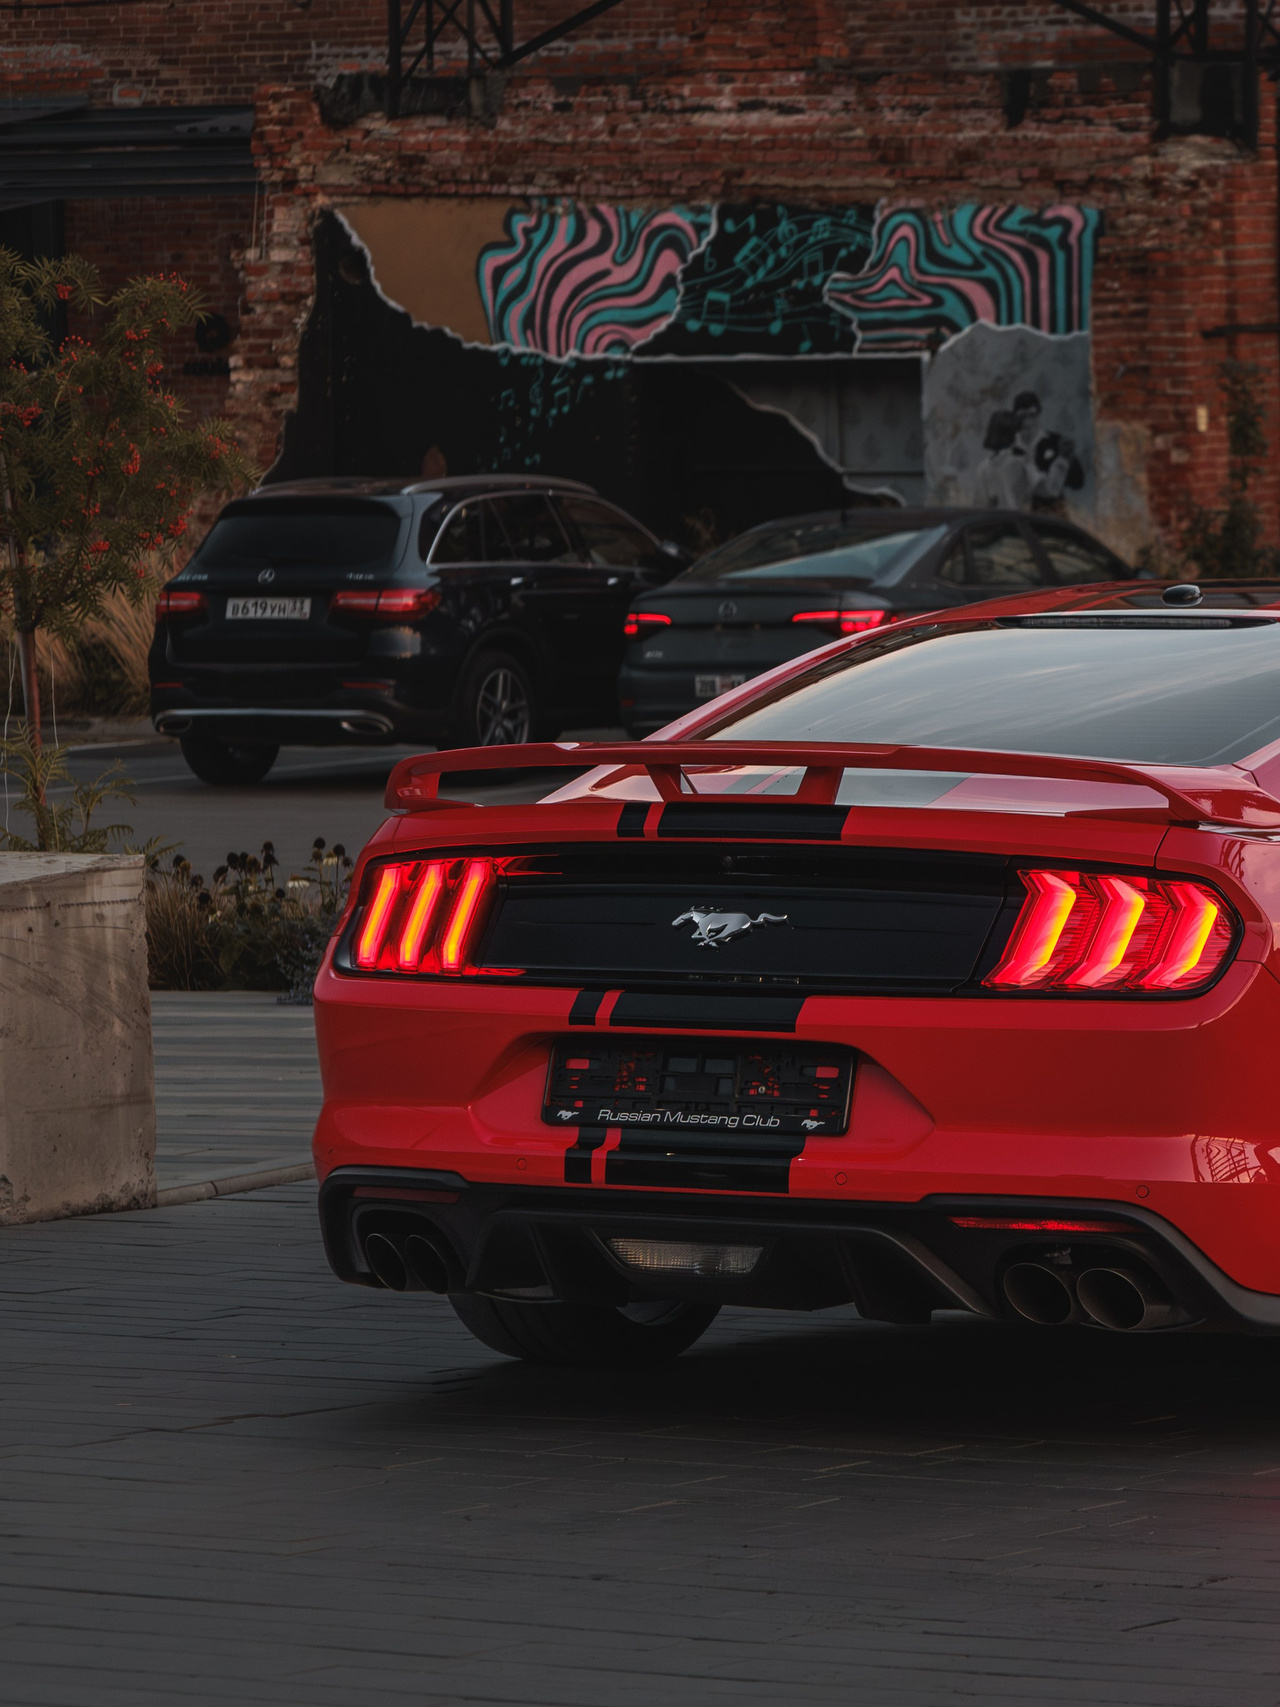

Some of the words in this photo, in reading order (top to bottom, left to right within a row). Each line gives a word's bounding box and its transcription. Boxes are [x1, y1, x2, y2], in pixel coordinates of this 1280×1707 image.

[597, 1109, 661, 1122] Russian
[663, 1111, 739, 1128] Mustang
[742, 1114, 781, 1127] Club
